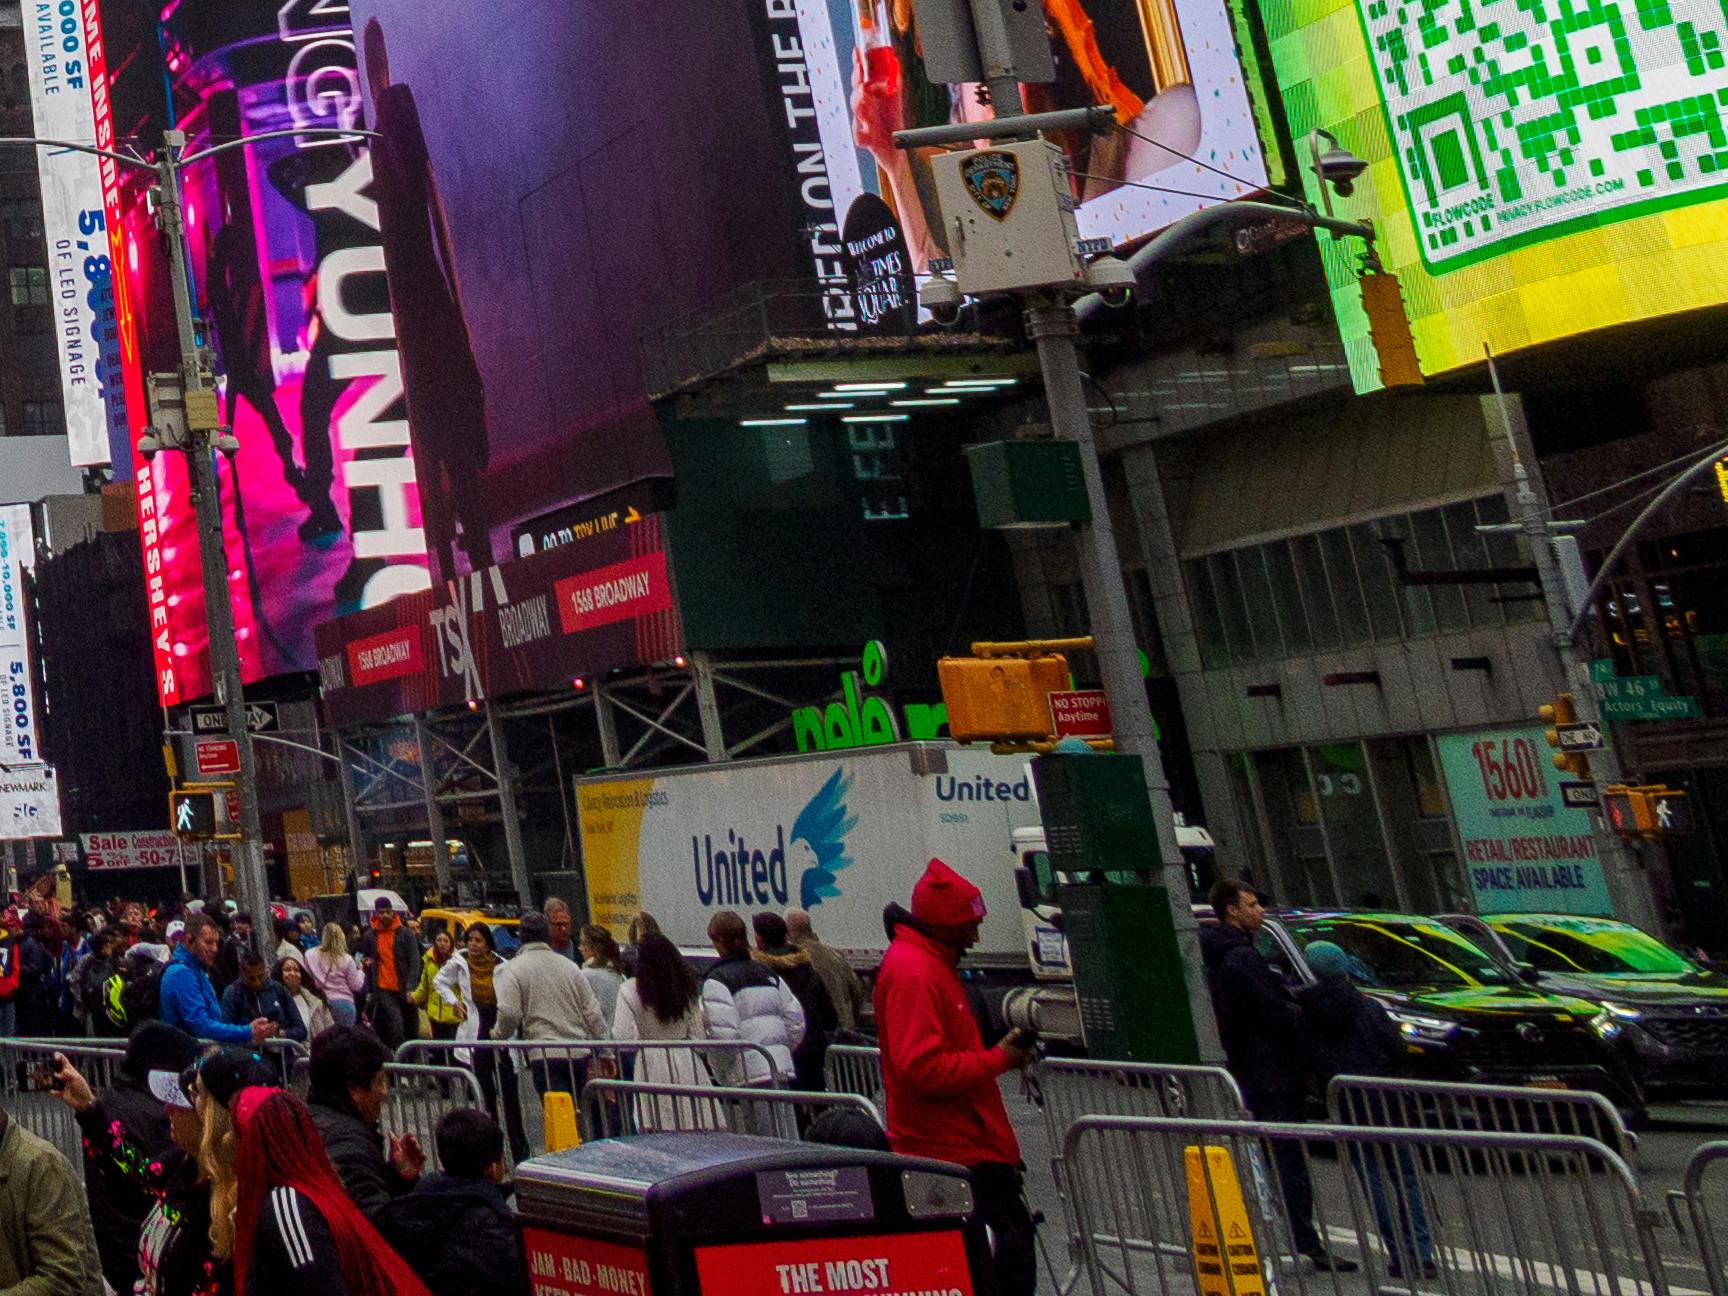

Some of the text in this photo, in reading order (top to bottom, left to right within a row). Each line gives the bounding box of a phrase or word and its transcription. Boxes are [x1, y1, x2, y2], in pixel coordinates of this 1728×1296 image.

[64, 64, 84, 91] SF
[773, 20, 818, 138] THE
[798, 144, 840, 220] ON
[1432, 197, 1495, 228] FLOWCODE
[1076, 237, 1108, 252] NYPD
[870, 251, 902, 278] TIMES
[54, 239, 70, 265] OF
[63, 307, 87, 386] SIGNAGE
[136, 465, 176, 696] HERSHEY'S
[571, 571, 651, 614] 1568 BROADWAY
[372, 640, 410, 667] BROADWAY
[429, 603, 485, 701] TSX
[497, 594, 552, 649] BROADWAY
[1625, 680, 1645, 696] 46
[9, 660, 33, 760] 5,800 SF
[1054, 697, 1069, 709] NO
[1604, 699, 1689, 713] Actors Equity
[203, 712, 228, 726] ONE
[1057, 710, 1099, 724] Anytime
[1472, 737, 1538, 802] 1560
[0, 781, 47, 794] NEWMARK
[934, 776, 1029, 802] United
[88, 833, 128, 851] Sale
[1466, 835, 1596, 862] RETAIL/RESTAURANT
[692, 824, 789, 907] United
[1473, 864, 1586, 891] SPACE AVAILABLE
[531, 1249, 556, 1280] JAM
[563, 1256, 591, 1286] BAD
[597, 1263, 645, 1296] MONEY
[775, 1257, 890, 1293] THE MOST
